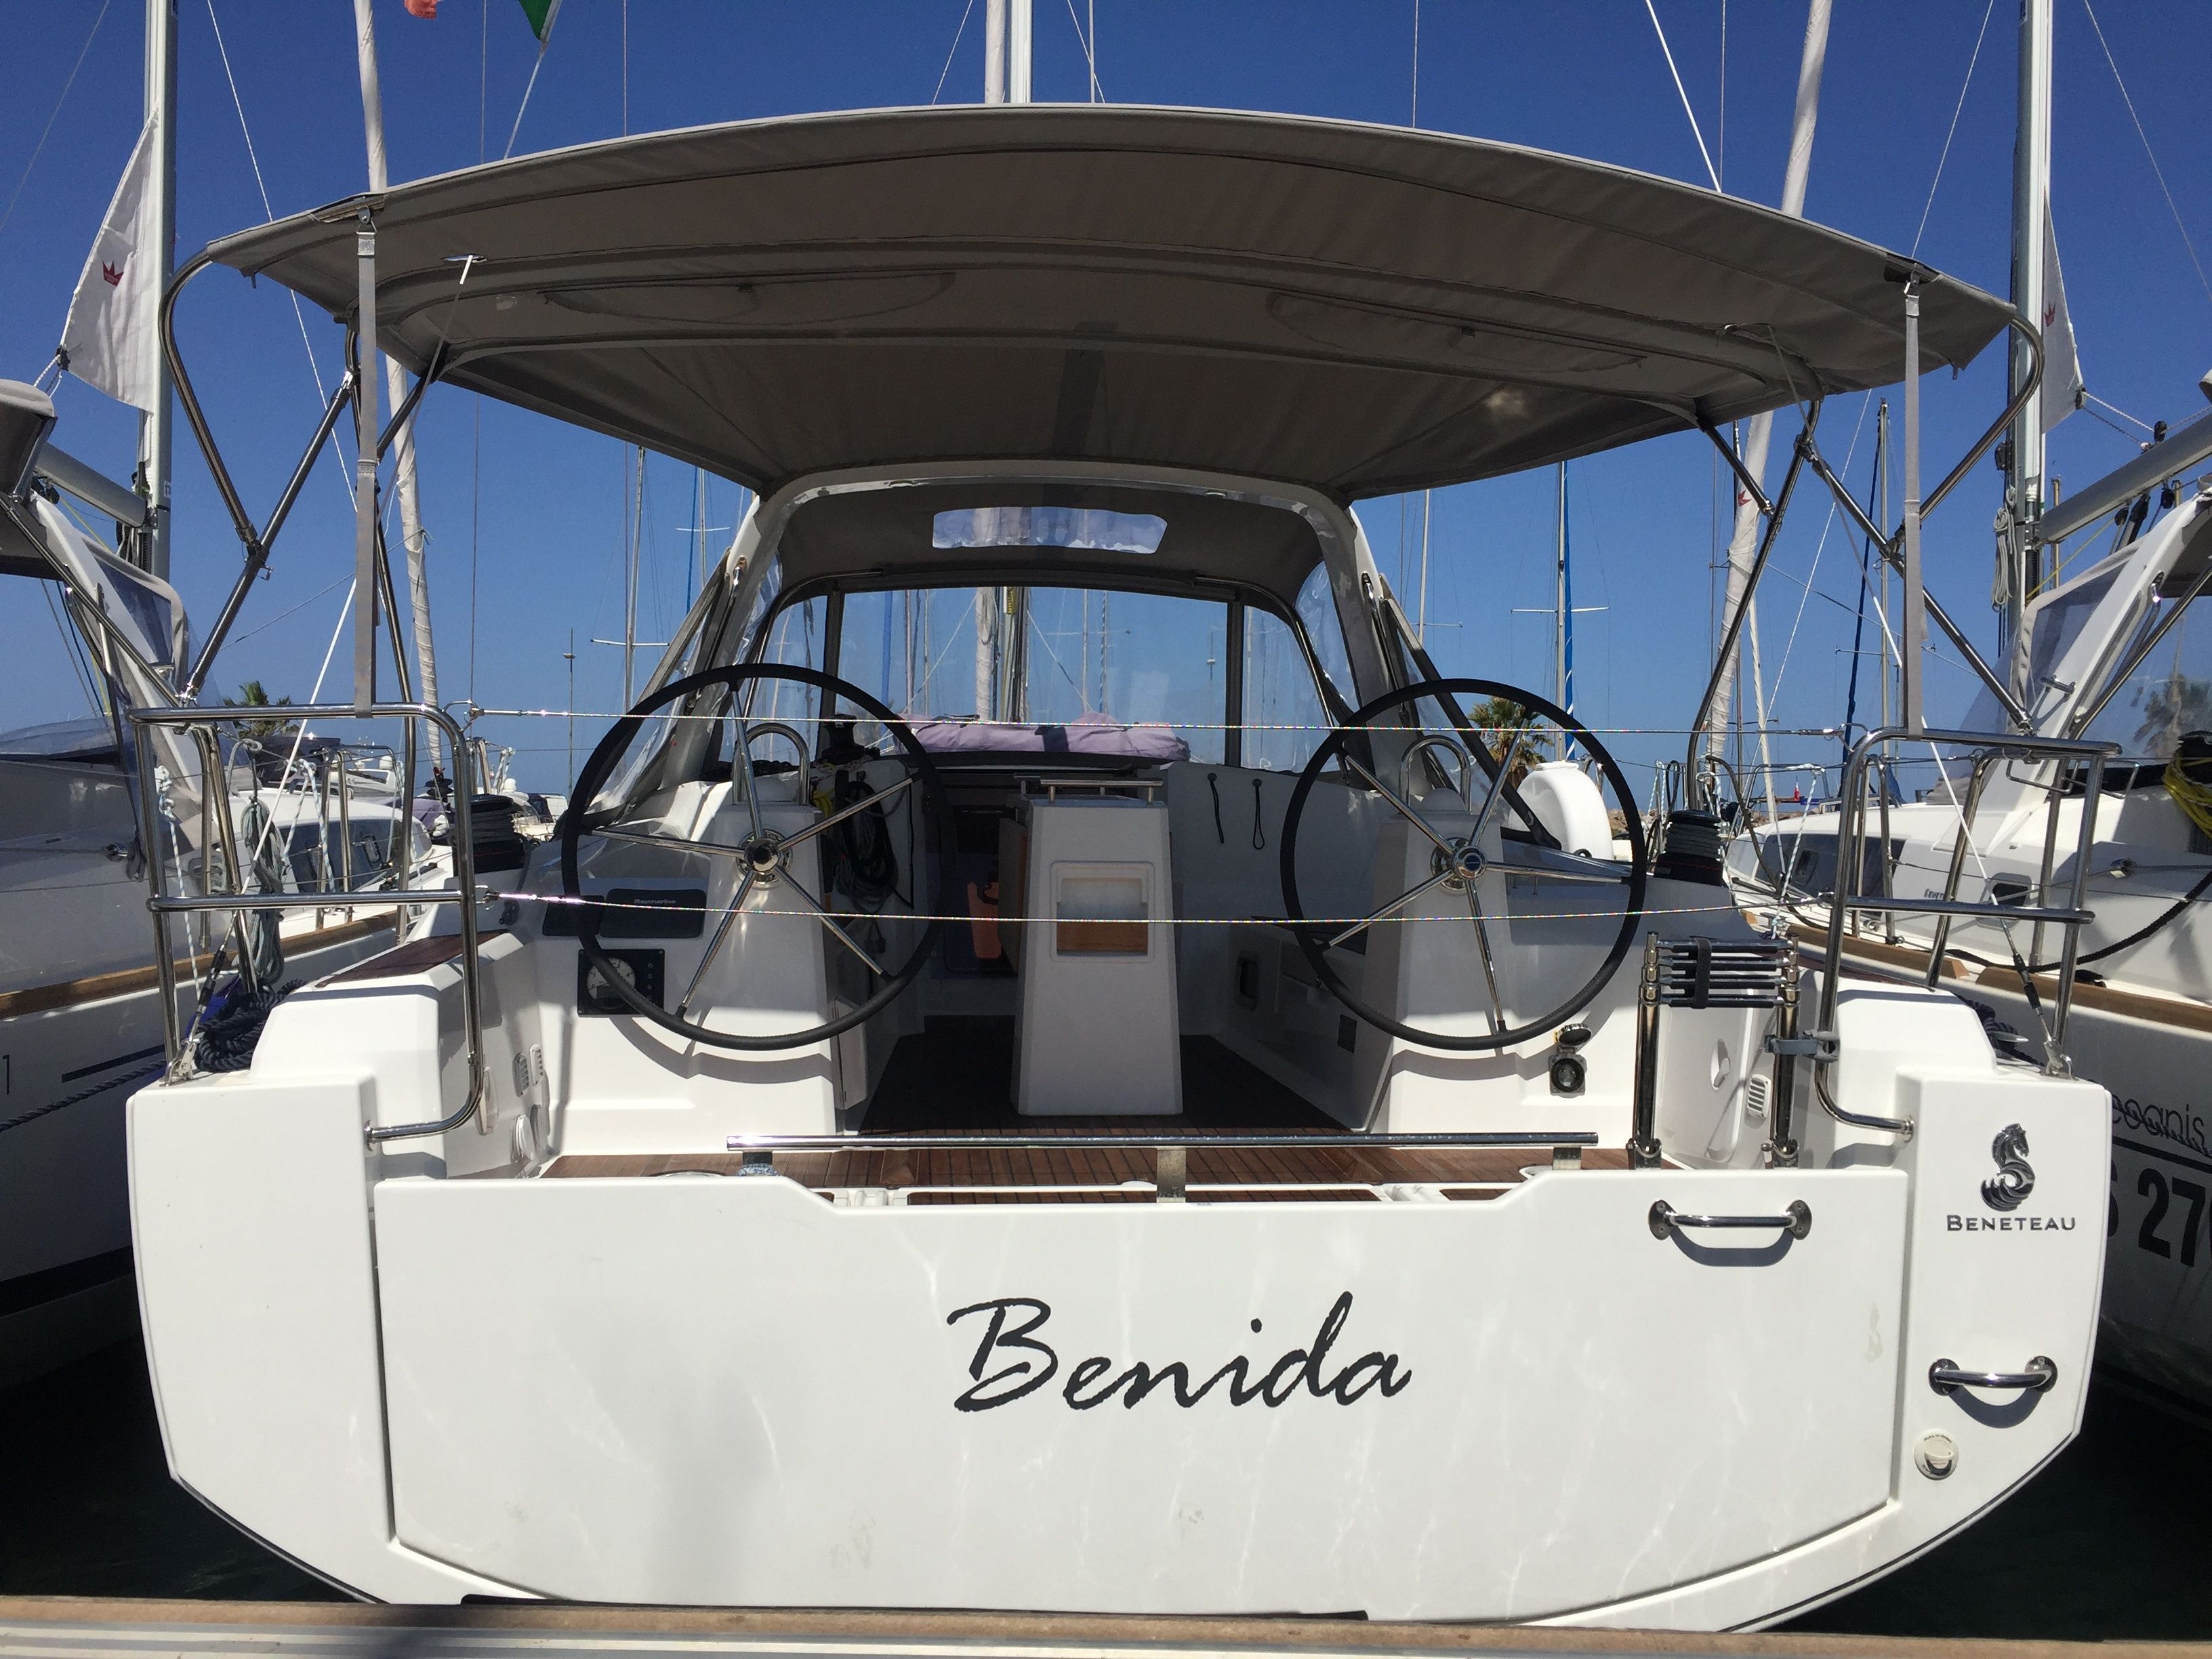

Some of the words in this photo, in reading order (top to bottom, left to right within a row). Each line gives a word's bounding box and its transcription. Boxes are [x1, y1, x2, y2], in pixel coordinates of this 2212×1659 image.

[1946, 1214, 2076, 1231] BENETEAU
[2137, 1168, 2212, 1268] 27
[946, 1291, 1412, 1412] Benida
